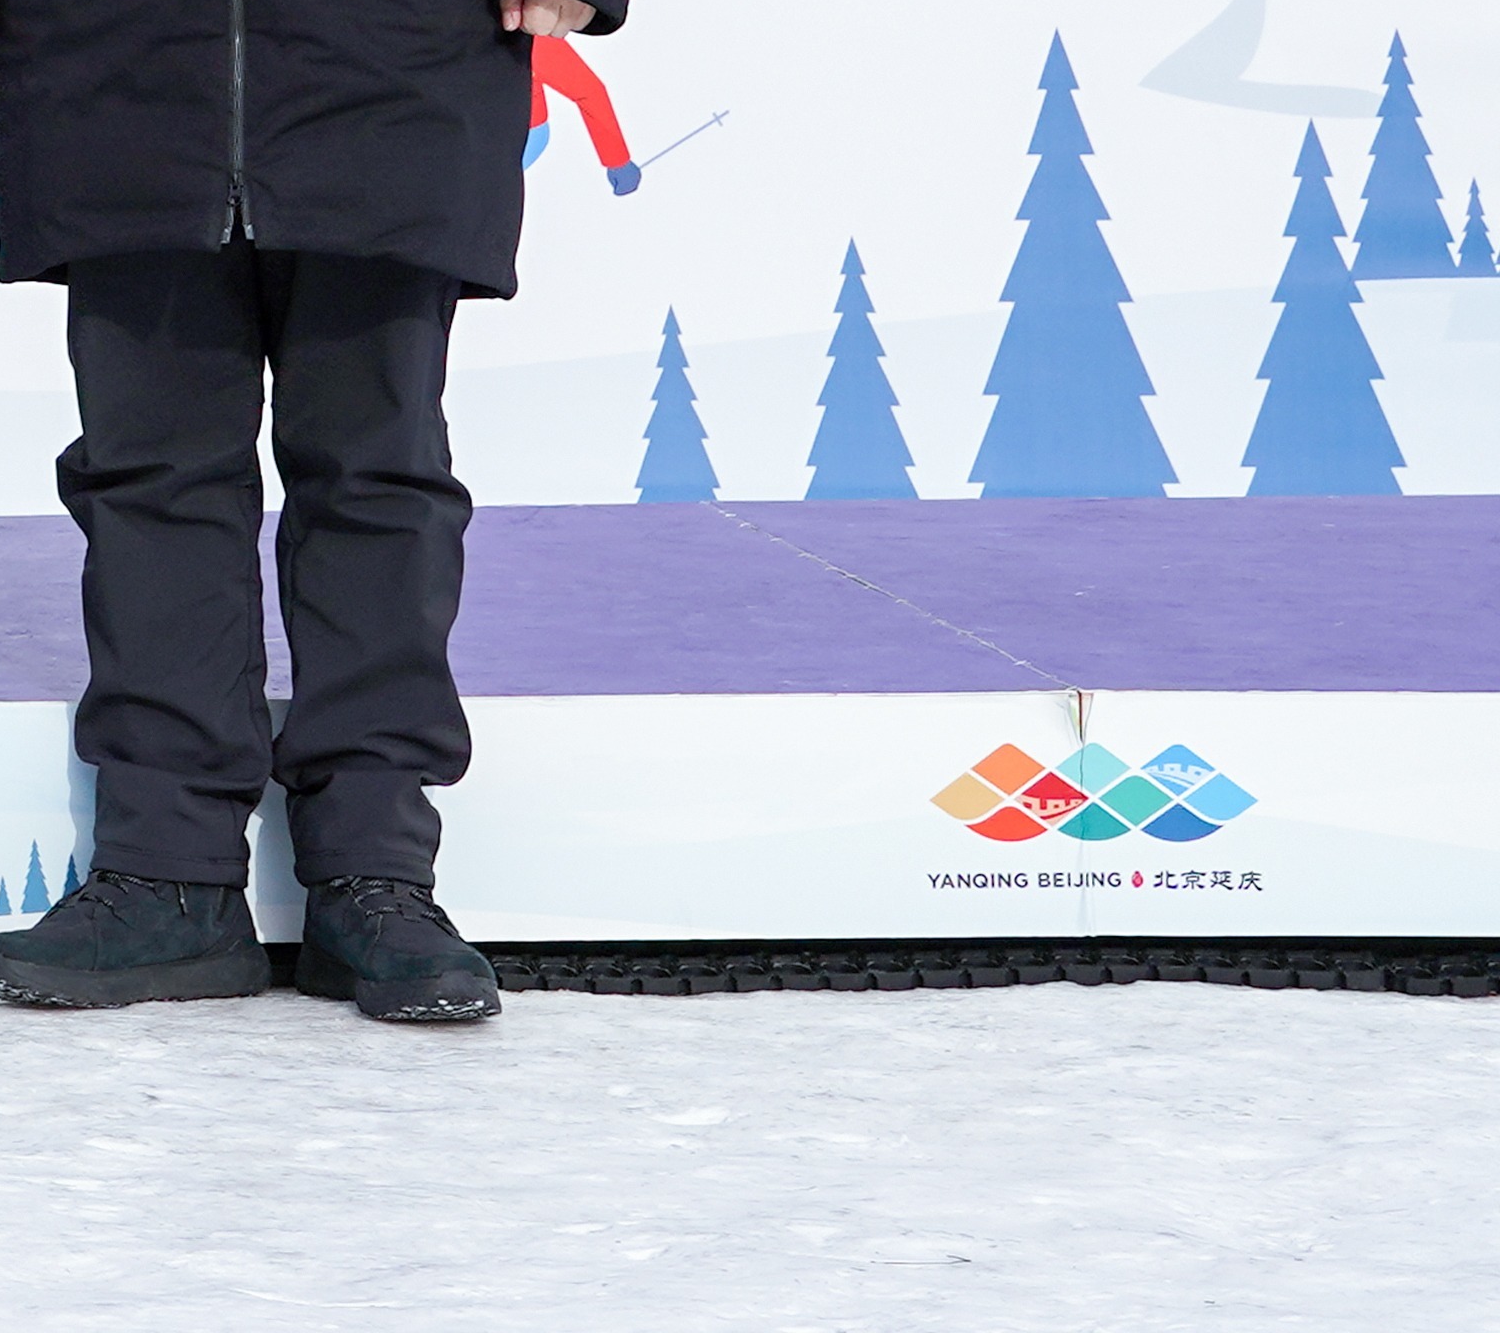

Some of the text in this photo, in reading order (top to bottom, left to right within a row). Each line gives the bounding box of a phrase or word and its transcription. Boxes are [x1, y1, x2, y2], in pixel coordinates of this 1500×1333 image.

[928, 871, 1122, 889] YANQING BEIJING
[1153, 869, 1264, 892] 北京延庆
